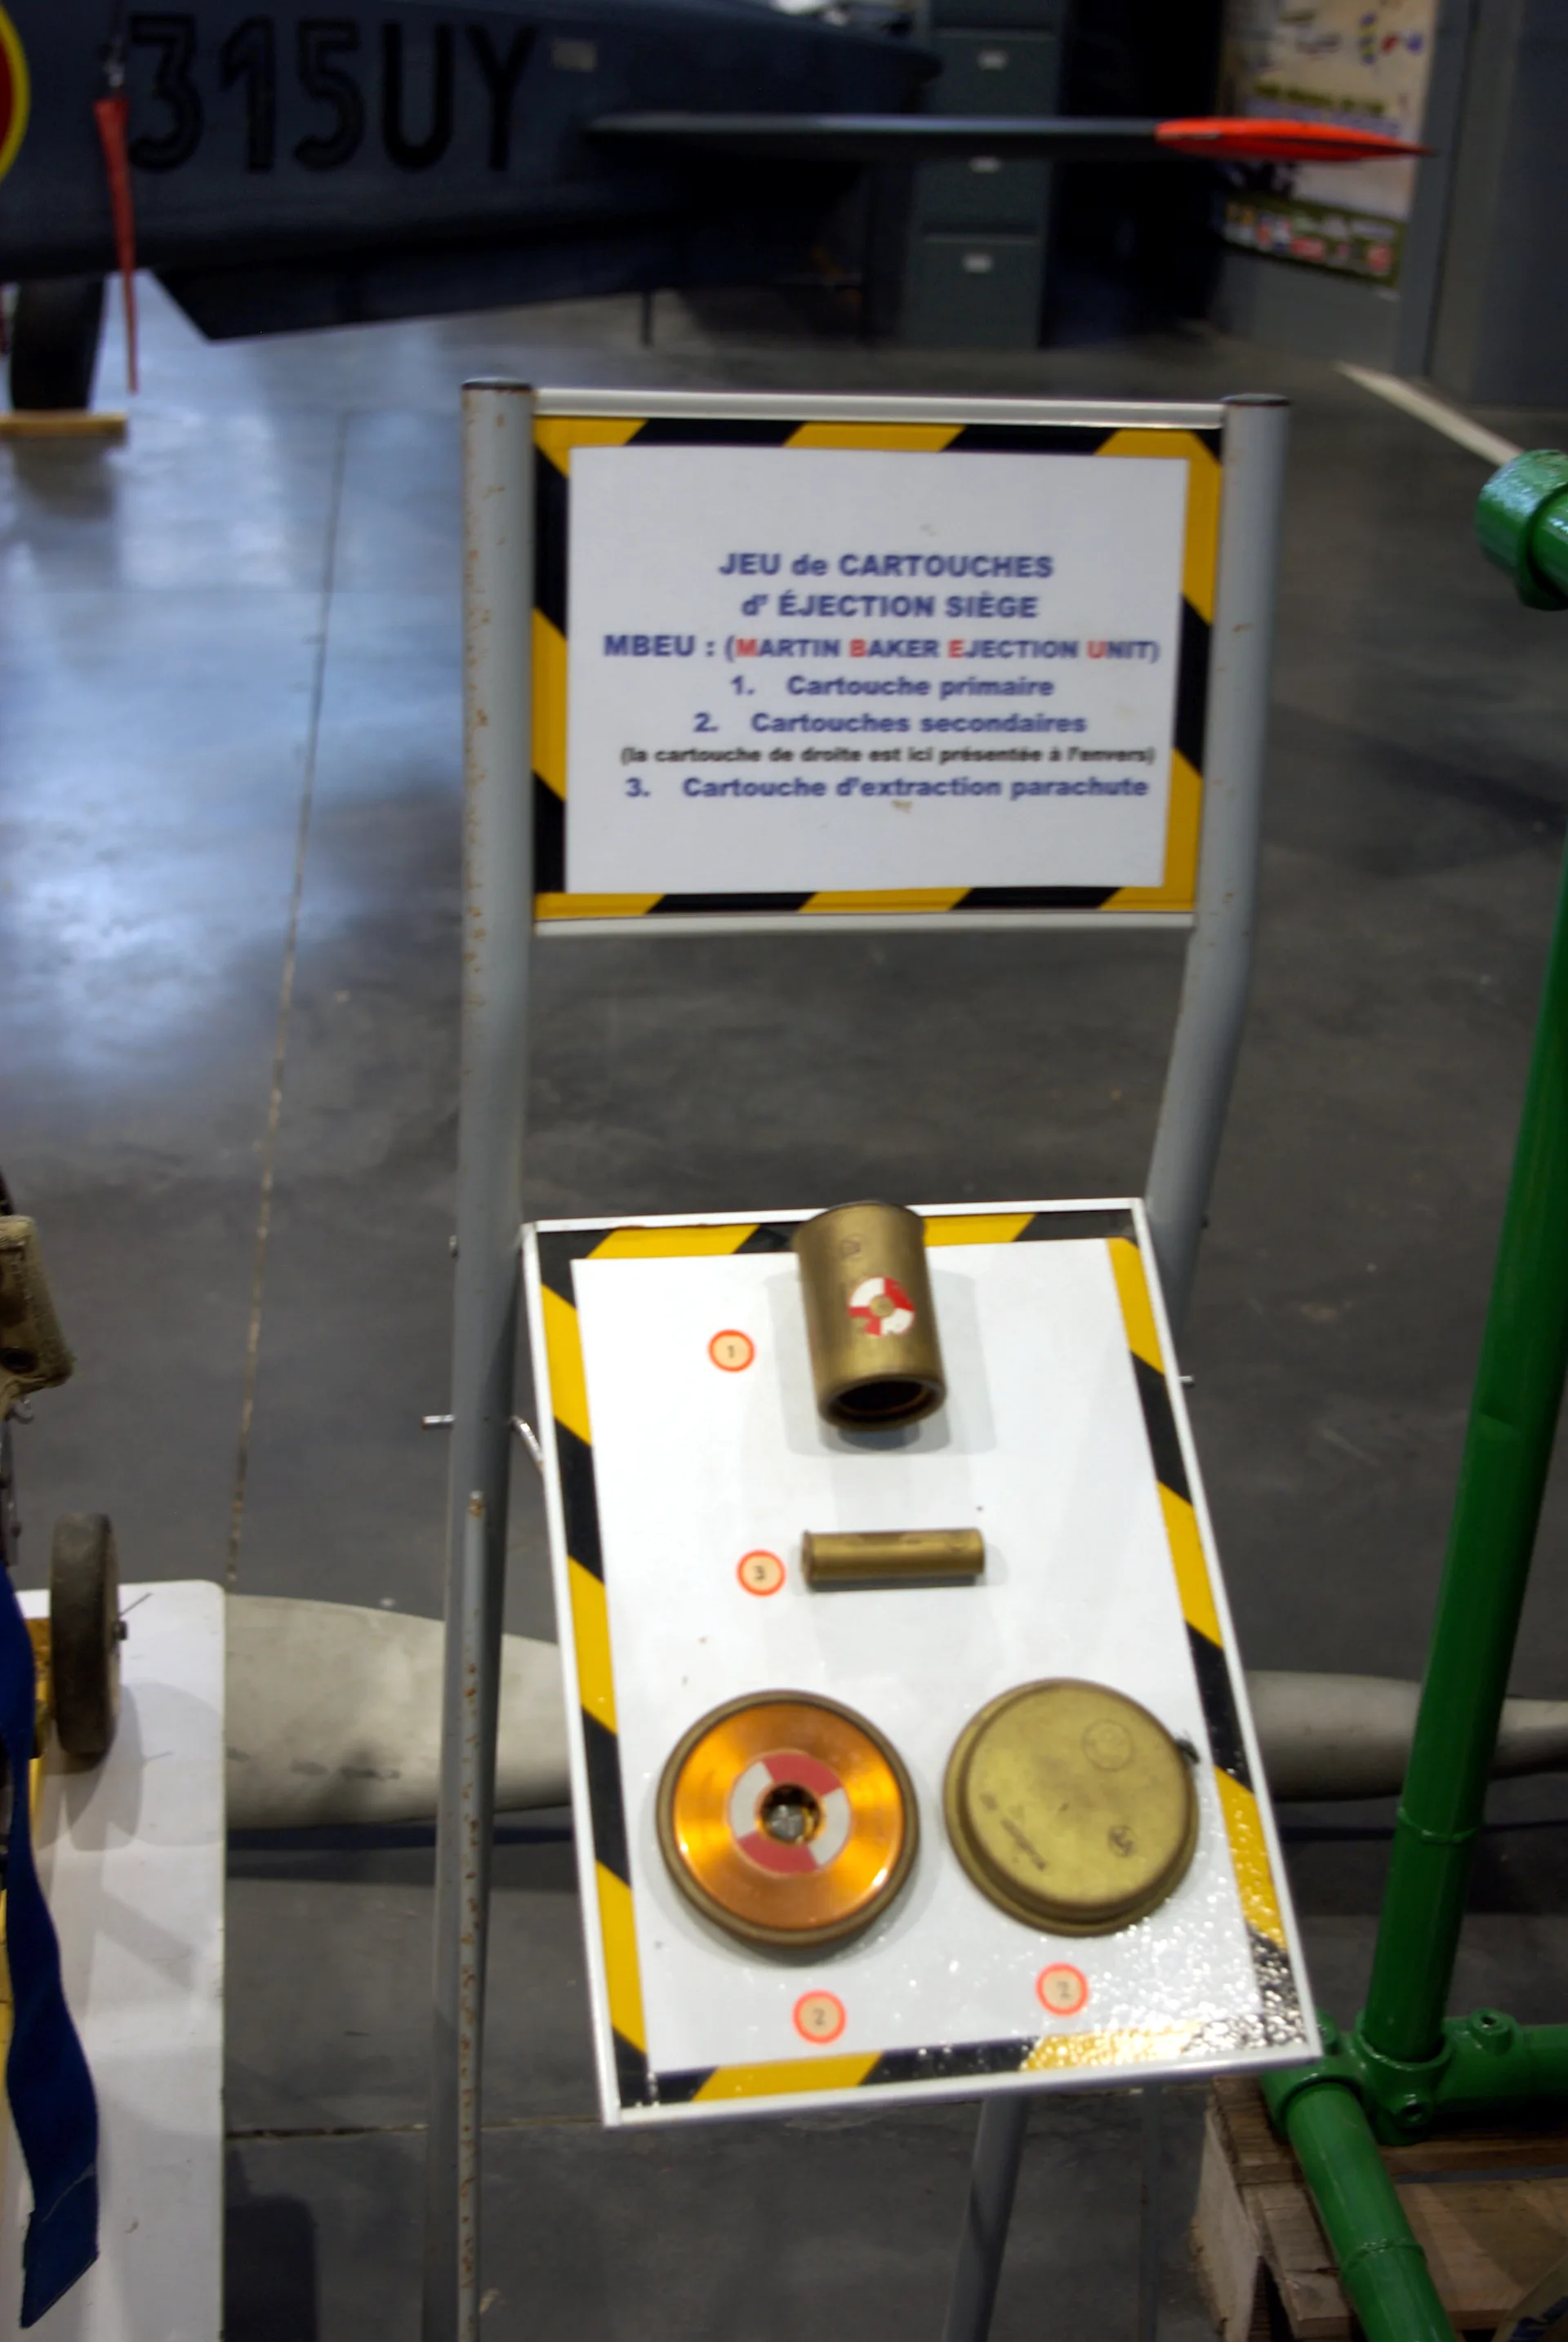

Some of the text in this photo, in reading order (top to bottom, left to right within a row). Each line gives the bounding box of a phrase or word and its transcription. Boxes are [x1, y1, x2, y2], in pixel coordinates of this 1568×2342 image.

[127, 15, 541, 173] 315UY
[719, 552, 1054, 579] JEU de CARTOUCHES
[778, 589, 936, 618] ÉJECTION
[945, 592, 1039, 619] SIÈGE
[604, 634, 696, 657] MBEU
[724, 635, 841, 662] (MARTIN
[849, 638, 940, 658] BAKER
[948, 639, 1080, 660] EJECTION
[1086, 639, 1160, 663] UNIT)
[731, 675, 1055, 701] 1. Cartouche primaire
[693, 711, 1088, 733] 2. Cartouches secondaires
[621, 746, 648, 766] (la
[654, 747, 763, 763] cartouche
[768, 747, 795, 763] de
[800, 746, 863, 763] droite
[868, 748, 902, 763] est
[907, 746, 933, 763] ici
[938, 746, 1044, 766] présentée
[1048, 746, 1063, 763] à
[626, 776, 1151, 801] 3. Cartouche d'extraction parachute
